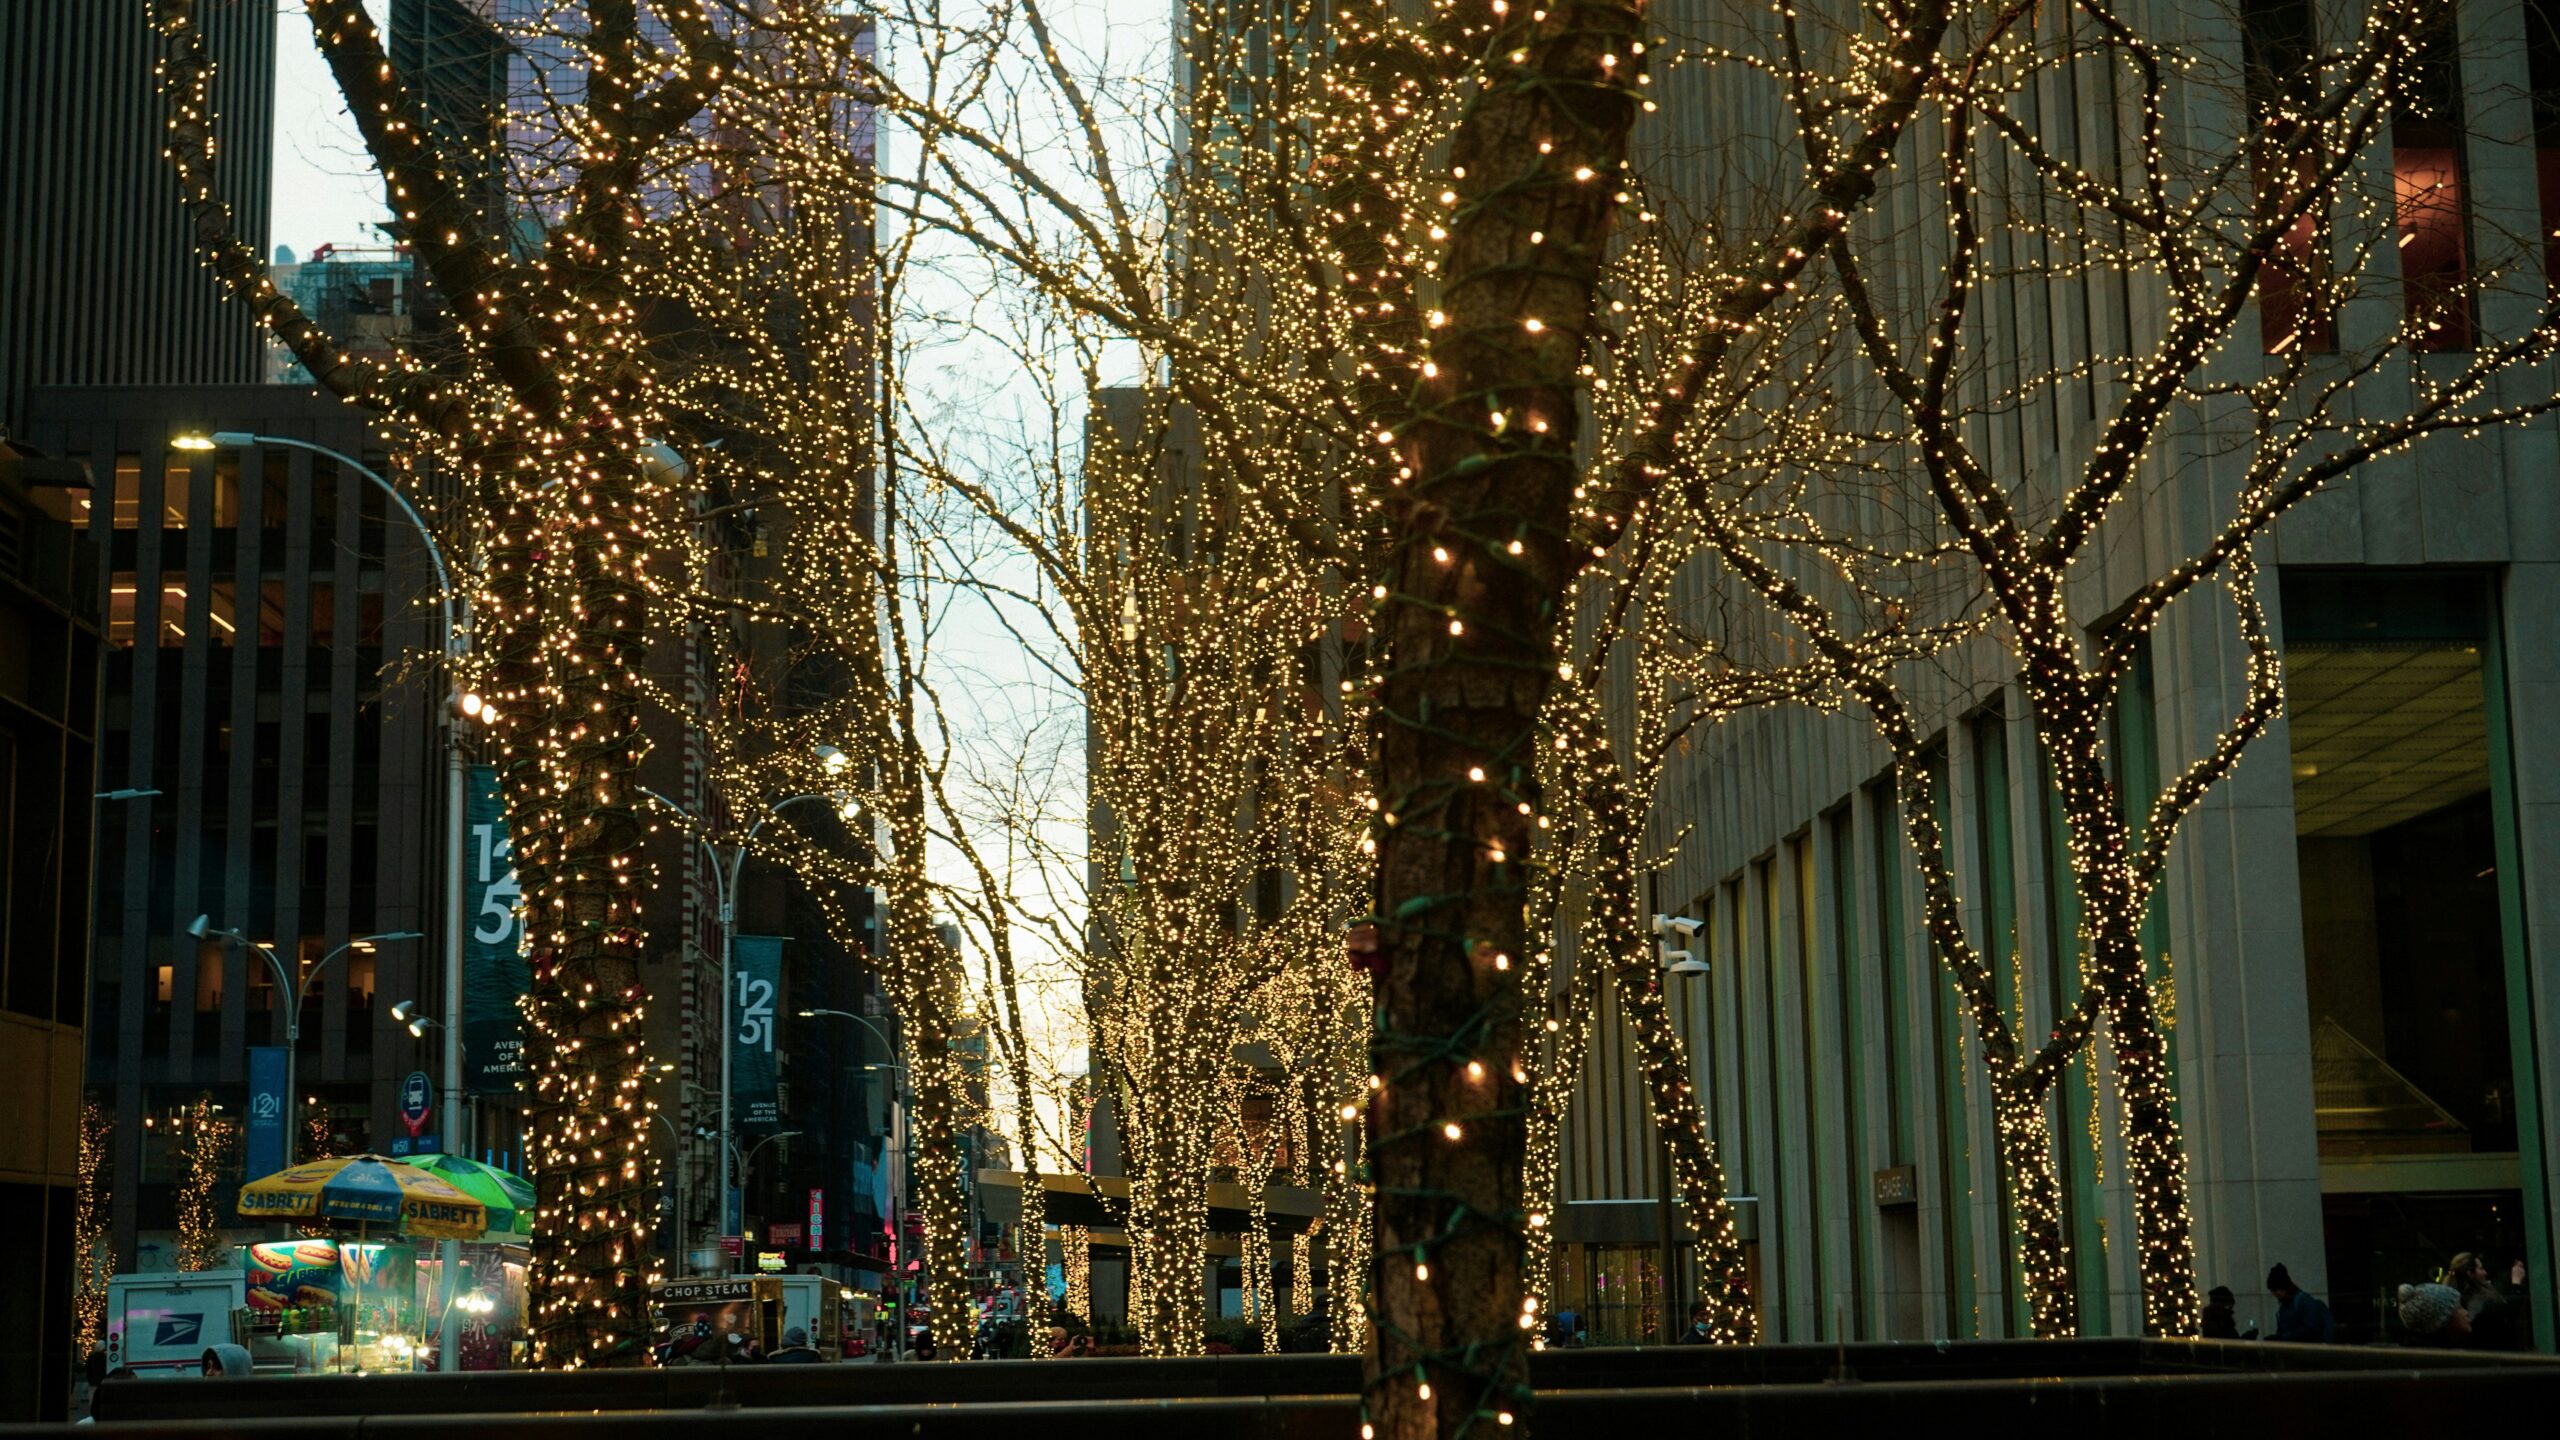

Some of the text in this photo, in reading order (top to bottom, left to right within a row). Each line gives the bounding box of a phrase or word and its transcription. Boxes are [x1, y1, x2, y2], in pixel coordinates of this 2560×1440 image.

[736, 971, 773, 1015] 12
[739, 1008, 773, 1052] 51
[493, 1040, 524, 1050] AVEN
[498, 1052, 514, 1062] OF
[482, 1063, 525, 1074] AMERIC
[1878, 1175, 1902, 1199] CHASE
[243, 1191, 314, 1210] SABRETT
[408, 1202, 481, 1225] SABRETT
[664, 1283, 749, 1298] CHOP STEAK
